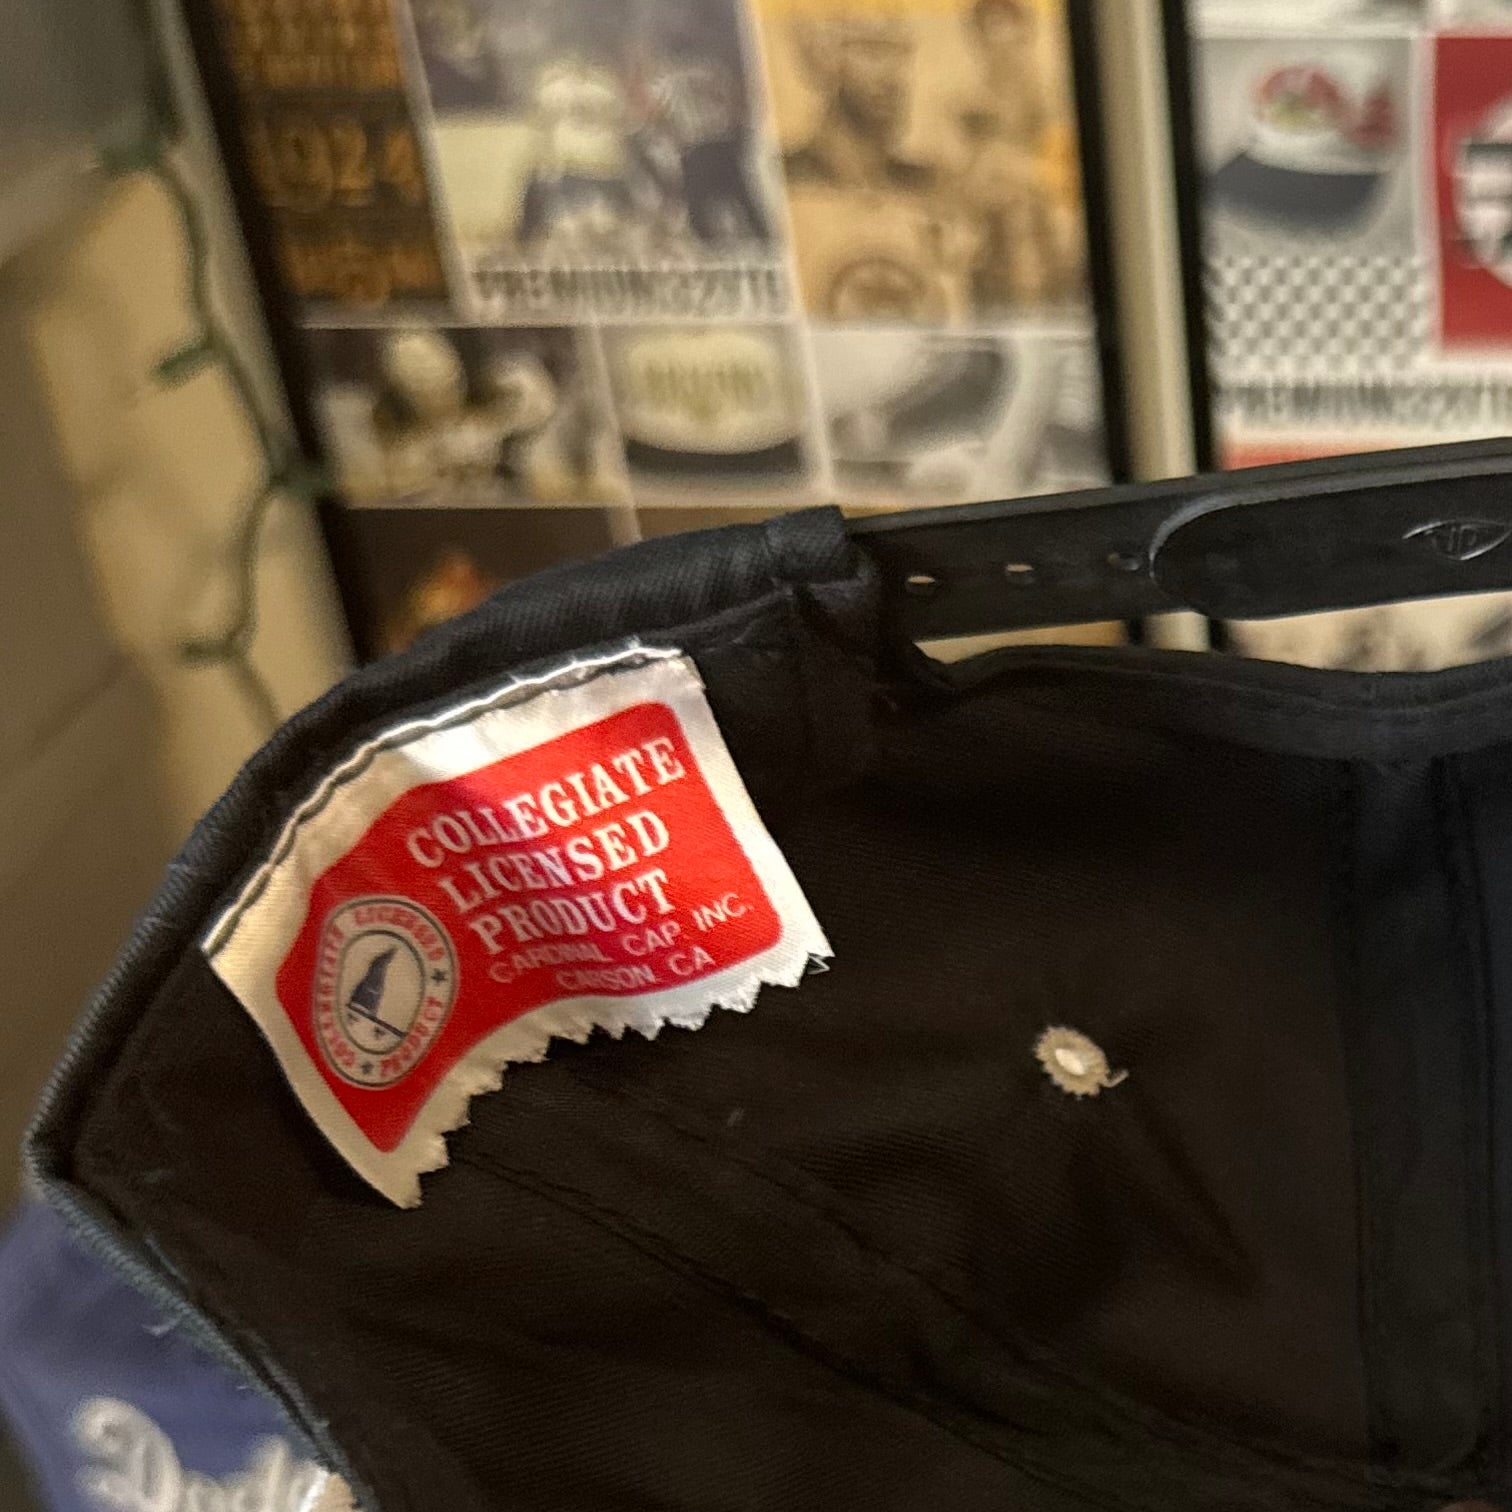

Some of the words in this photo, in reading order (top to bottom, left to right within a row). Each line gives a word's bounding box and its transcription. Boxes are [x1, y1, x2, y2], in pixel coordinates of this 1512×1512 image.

[406, 736, 686, 868] COLLEGIATE
[438, 809, 670, 914] LICENSED
[469, 867, 675, 955] PRODUCT
[666, 944, 717, 977] CA
